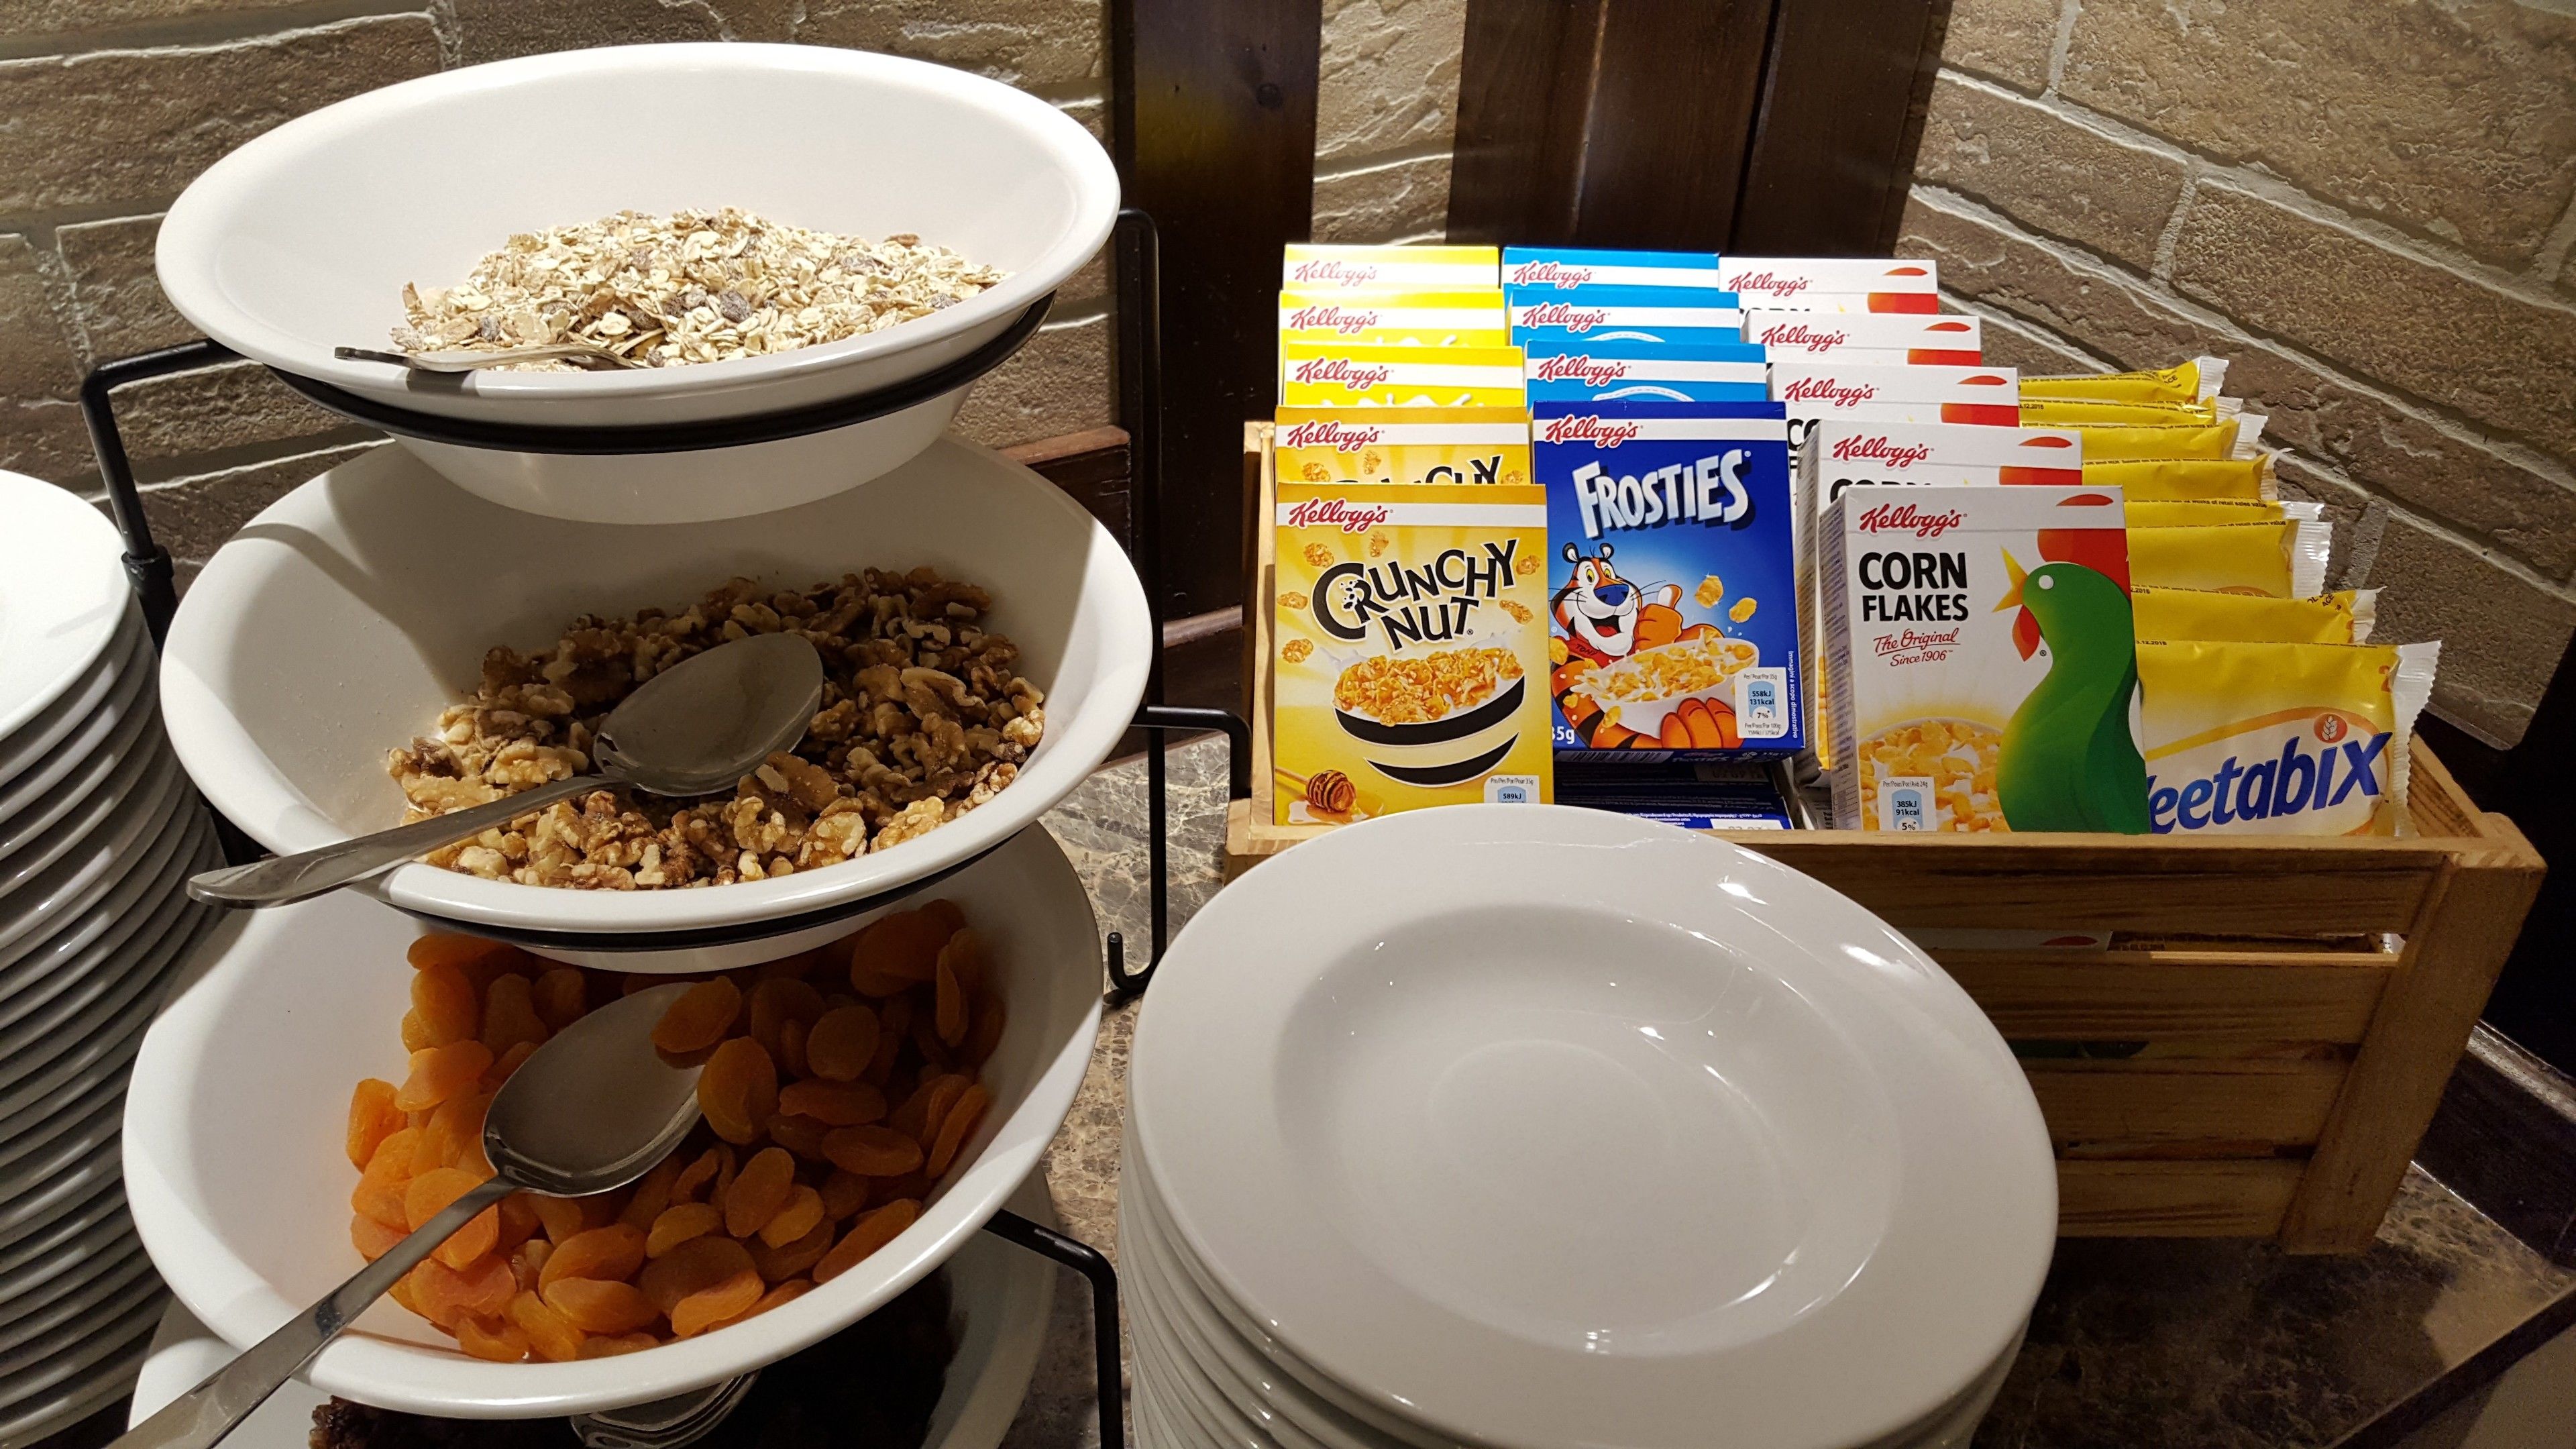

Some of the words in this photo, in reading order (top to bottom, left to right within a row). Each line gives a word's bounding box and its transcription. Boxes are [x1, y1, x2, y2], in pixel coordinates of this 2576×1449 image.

[1295, 261, 1378, 284] Kellogg's
[1513, 262, 1593, 288] Kellogg's
[1728, 271, 1808, 297] Kellogg's
[1291, 306, 1378, 332] Kellogg's
[1523, 304, 1605, 331] Kellogg's
[1761, 323, 1845, 352] Kellogg's
[1296, 359, 1388, 388] Kellogg's
[1538, 355, 1627, 385] Kellogg's
[1784, 377, 1875, 407] Kellogg's
[1287, 422, 1380, 452] Kellogg's
[1545, 415, 1638, 447] Kellogg's
[1833, 434, 1930, 468] Kellogg's
[1572, 449, 1748, 539] FROSTIES
[1289, 500, 1387, 532] Kellogg's
[1860, 503, 1962, 537] Kellogg's
[1859, 551, 1967, 590] CORN
[1312, 539, 1517, 640] CRUNCHY
[1862, 593, 1969, 623] FLAKES
[1381, 597, 1479, 652] NUT
[1576, 643, 1598, 656] TONY
[1873, 634, 1898, 653] The
[1900, 627, 1960, 650] Original
[1890, 654, 1920, 667] Since
[1921, 649, 1947, 662] 1906
[2146, 731, 2393, 835] eetabix
